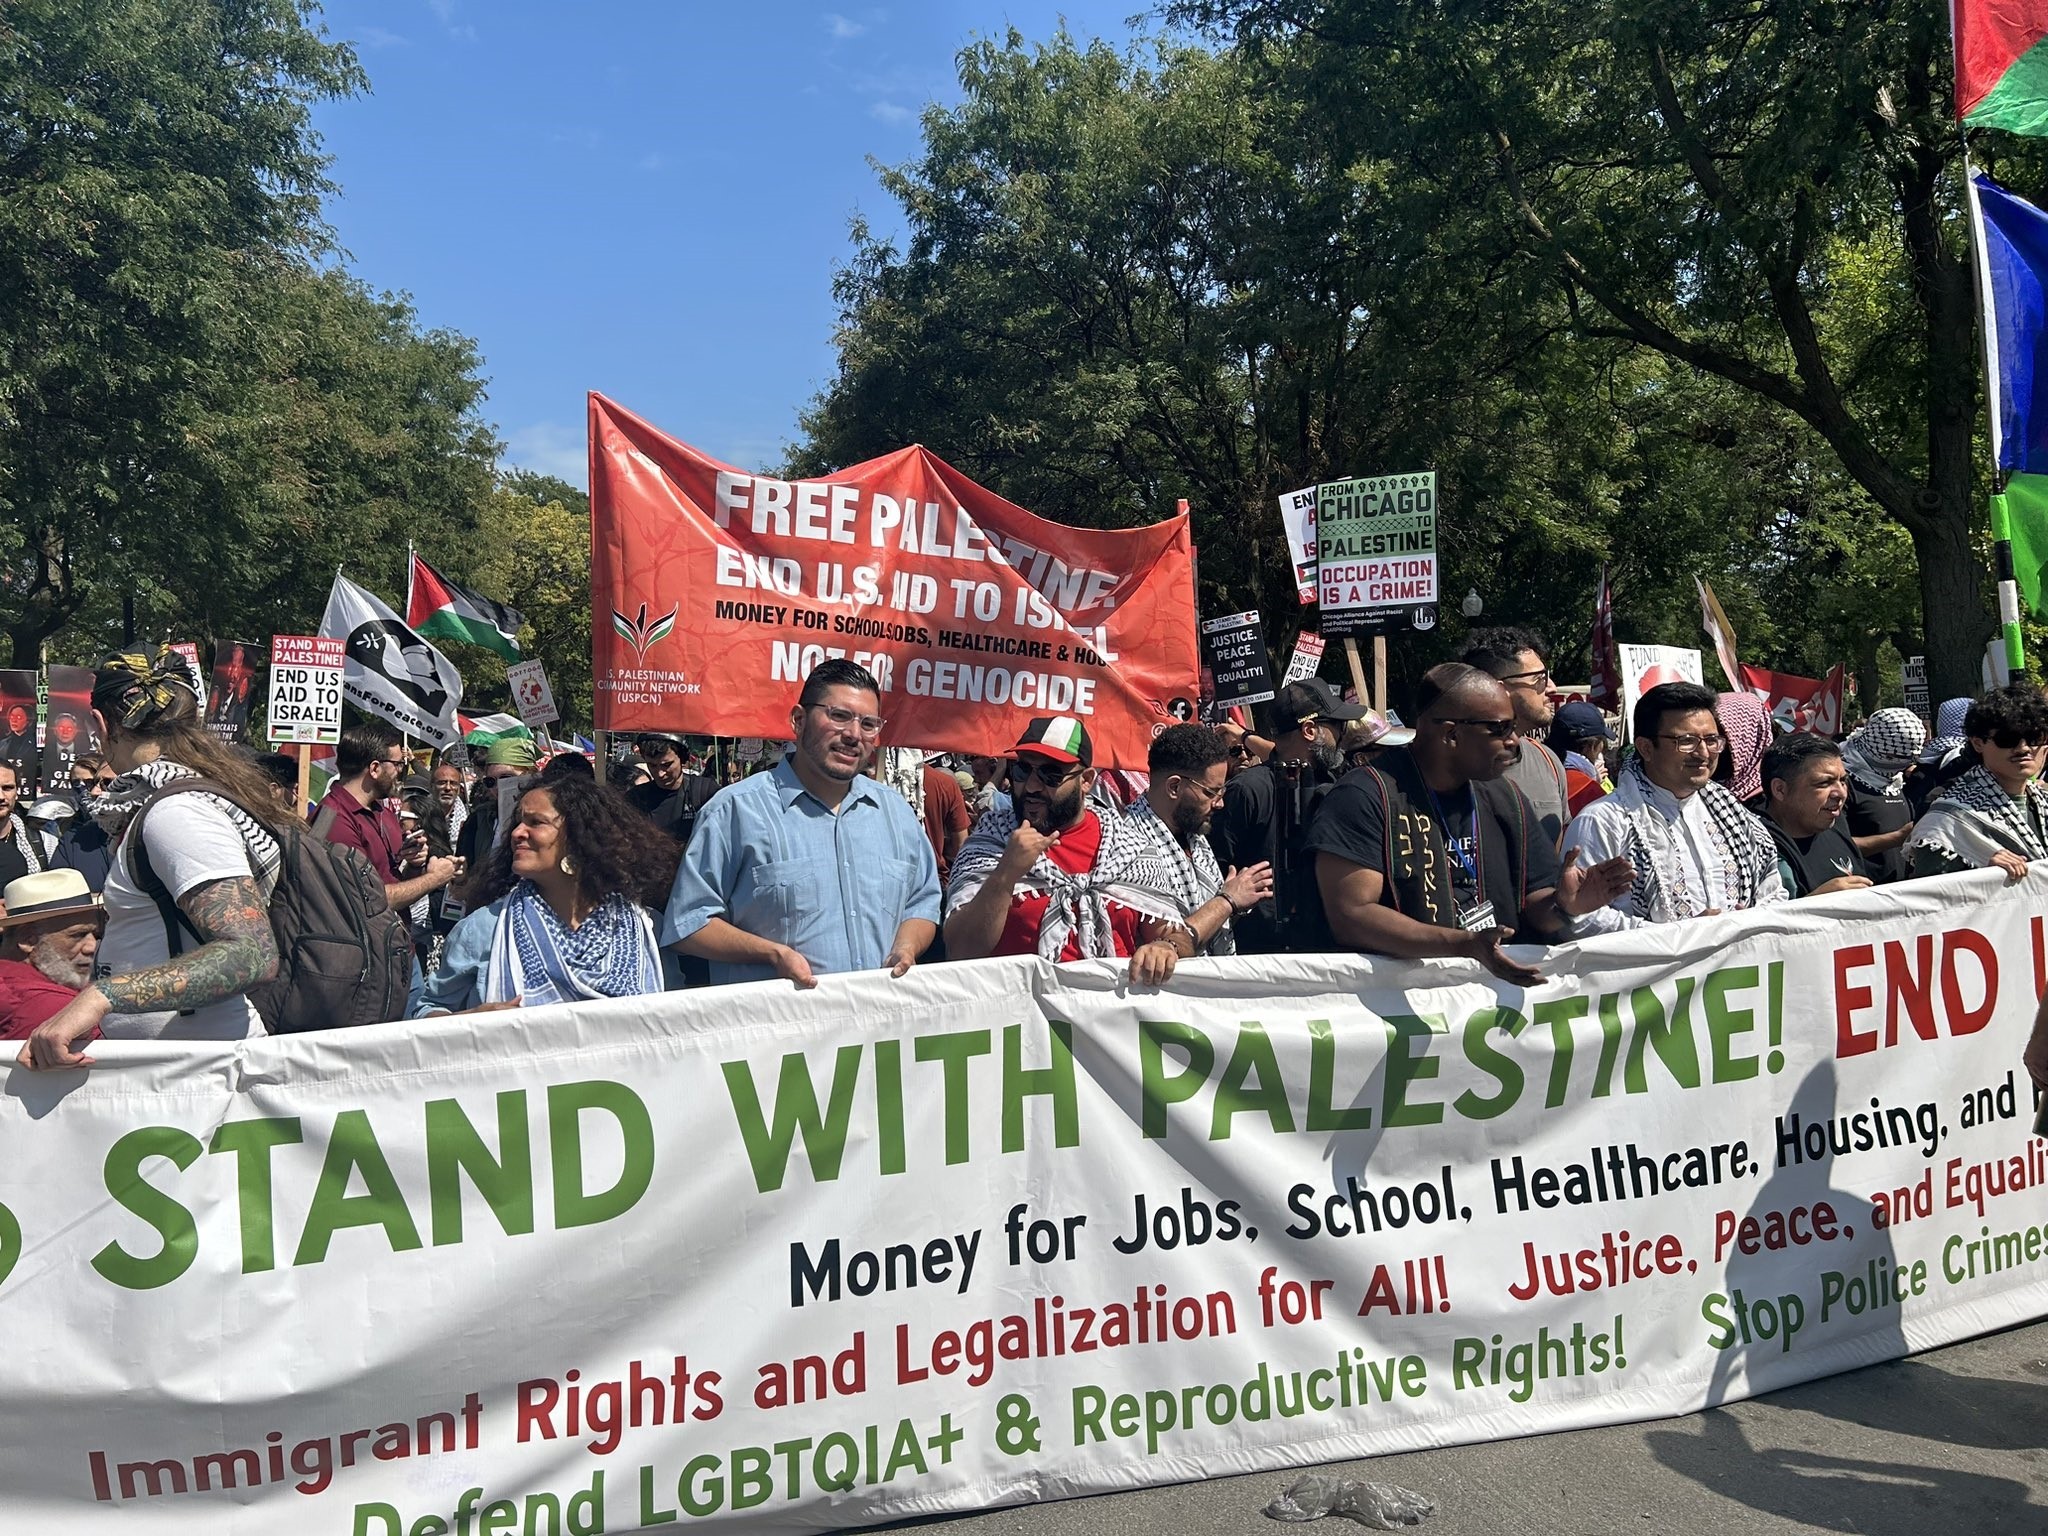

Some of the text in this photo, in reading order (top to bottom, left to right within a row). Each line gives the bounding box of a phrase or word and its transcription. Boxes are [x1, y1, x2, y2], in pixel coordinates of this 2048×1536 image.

[1321, 482, 1354, 497] FROM
[714, 470, 859, 544] FREE
[1320, 488, 1432, 522] CHICAGO
[1416, 515, 1431, 528] TO
[1321, 530, 1432, 558] PALESTINE
[1322, 560, 1432, 584] OCCUPATION
[716, 543, 802, 596] END
[817, 562, 883, 606] U.S.
[950, 579, 1001, 622] TO
[1323, 580, 1432, 605] IS A CRIME!
[1215, 614, 1244, 625] STAND WITH
[716, 600, 787, 625] MONEY
[793, 608, 829, 630] FOR
[891, 625, 932, 648] OBS,
[938, 630, 1052, 659] HEALTHCARE
[1056, 645, 1069, 662] &
[1210, 629, 1258, 649] JUSTICE.
[1300, 633, 1317, 644] STAND
[275, 638, 343, 653] STAND WITH
[1216, 644, 1255, 661] PEACE.
[274, 651, 343, 666] PALESTINE!
[1230, 659, 1246, 669] AND
[1293, 654, 1306, 666] END
[1628, 646, 1661, 677] FUND
[276, 669, 339, 686] END U.S
[619, 669, 685, 682] PALESTINIAN
[1217, 666, 1263, 684] EQUALITY!
[1288, 666, 1314, 679] AID TO
[274, 686, 339, 704] AID TO
[650, 682, 701, 694] NETWORK
[905, 658, 1097, 715] GENOCIDE
[617, 692, 662, 706] (USPCN)
[274, 705, 338, 722] ISRAEL!
[343, 680, 444, 740] ansForPeace.org
[207, 723, 238, 732] DEMOCRATS
[89, 1079, 655, 1291] STAND
[720, 1020, 1080, 1194] WITH
[1139, 961, 1785, 1141] PALESTINE!
[1833, 928, 1999, 1059] END
[789, 1228, 982, 1308] Money
[1004, 1203, 1087, 1266] for
[1112, 1187, 1259, 1255] Jobs,
[1284, 1165, 1472, 1240] School,
[1491, 1140, 1759, 1214] Healthcare,
[1775, 1097, 1948, 1168] Housing,
[1960, 1070, 2016, 1130] and
[88, 1137, 2048, 1501] Immigrant Rights and Legalization for All! Justice, Peace, and Equali
[353, 1470, 605, 1536] Defend
[640, 1412, 964, 1527] LGBTQIA+
[994, 1392, 1042, 1457] &
[1072, 1346, 1427, 1455] Reproductive
[1452, 1314, 1627, 1403] Rights!
[1701, 1287, 1805, 1353] Stop
[1820, 1256, 1927, 1324] Police
